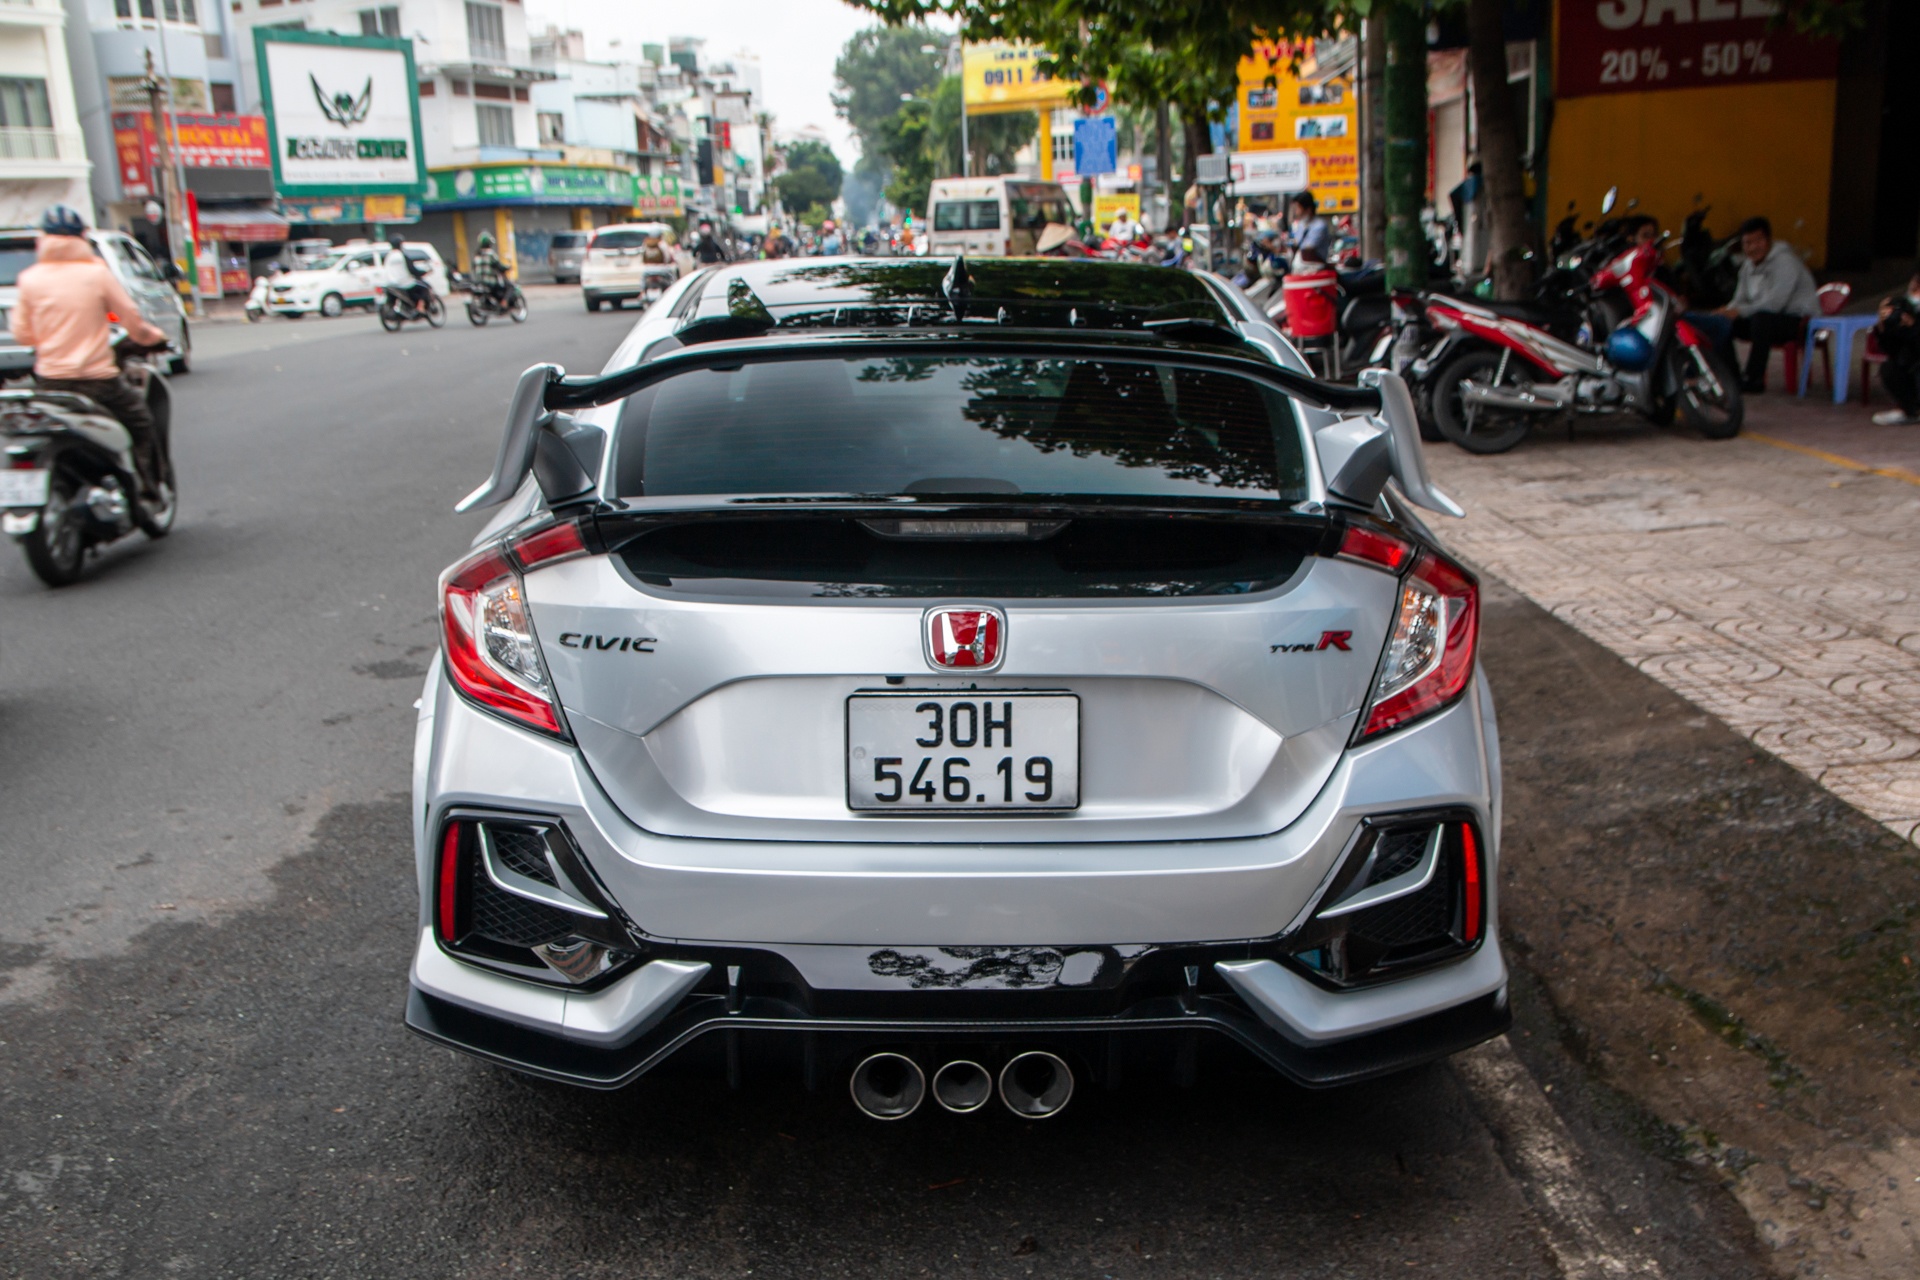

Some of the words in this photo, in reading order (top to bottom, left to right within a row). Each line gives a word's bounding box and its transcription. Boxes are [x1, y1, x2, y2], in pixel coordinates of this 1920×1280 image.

[985, 67, 1022, 85] 0911
[1600, 46, 1668, 83] 20%
[1701, 39, 1772, 77] 50%
[559, 632, 658, 653] CIVIC
[915, 701, 1013, 748] 30H
[873, 755, 1053, 803] 546.19
